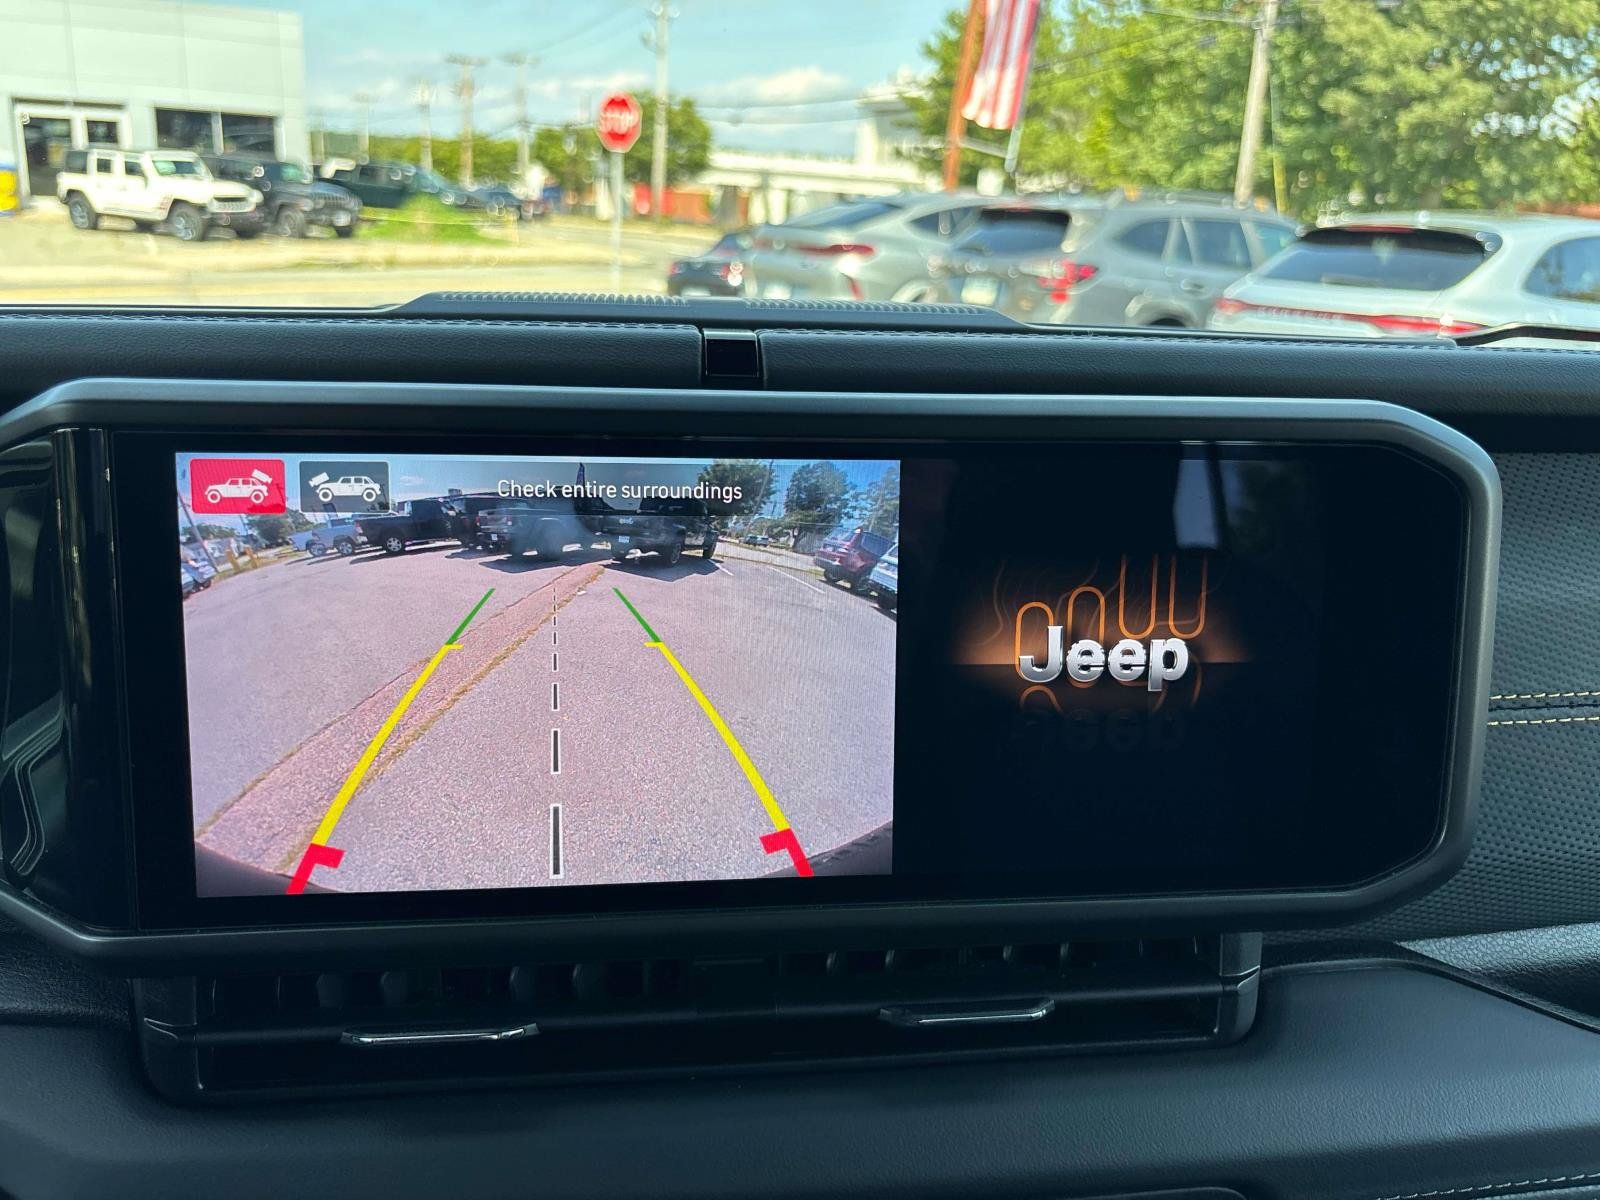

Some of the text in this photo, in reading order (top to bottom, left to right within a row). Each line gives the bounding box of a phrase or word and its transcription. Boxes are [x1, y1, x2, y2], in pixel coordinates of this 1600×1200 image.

[600, 110, 640, 133] STOP
[497, 479, 743, 503] Check entire surroundings
[1018, 625, 1189, 692] Jeep
